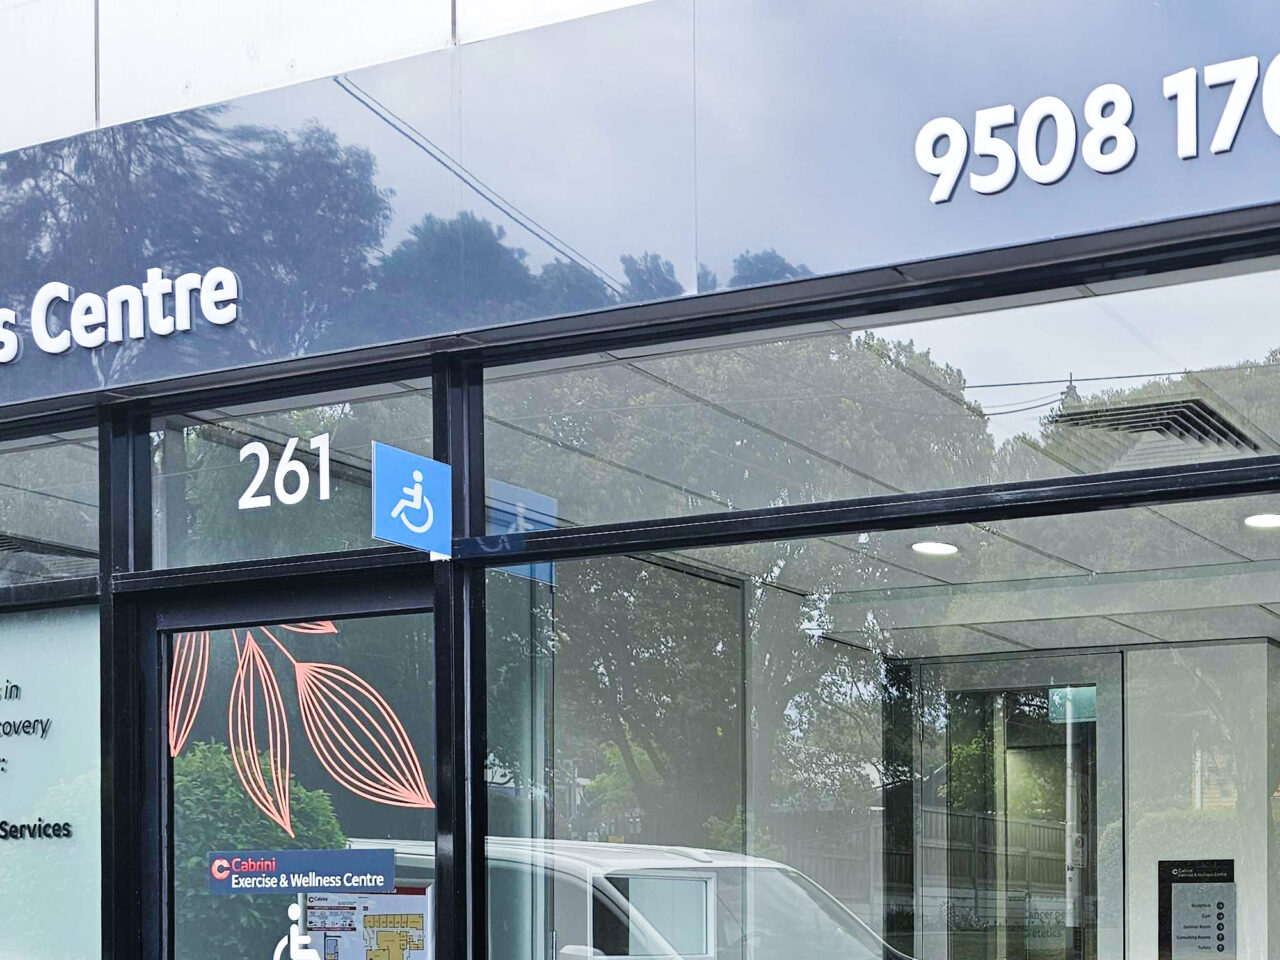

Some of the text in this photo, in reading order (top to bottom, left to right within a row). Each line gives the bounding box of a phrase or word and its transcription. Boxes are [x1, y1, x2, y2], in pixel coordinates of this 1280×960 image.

[915, 83, 1136, 204] 9508
[31, 266, 239, 354] Centre
[238, 433, 331, 510] 261
[4, 679, 20, 699] in
[0, 718, 50, 738] overy
[0, 817, 71, 839] Services
[231, 857, 276, 873] Cabrini
[231, 872, 384, 888] Exercise & Wellness Centre
